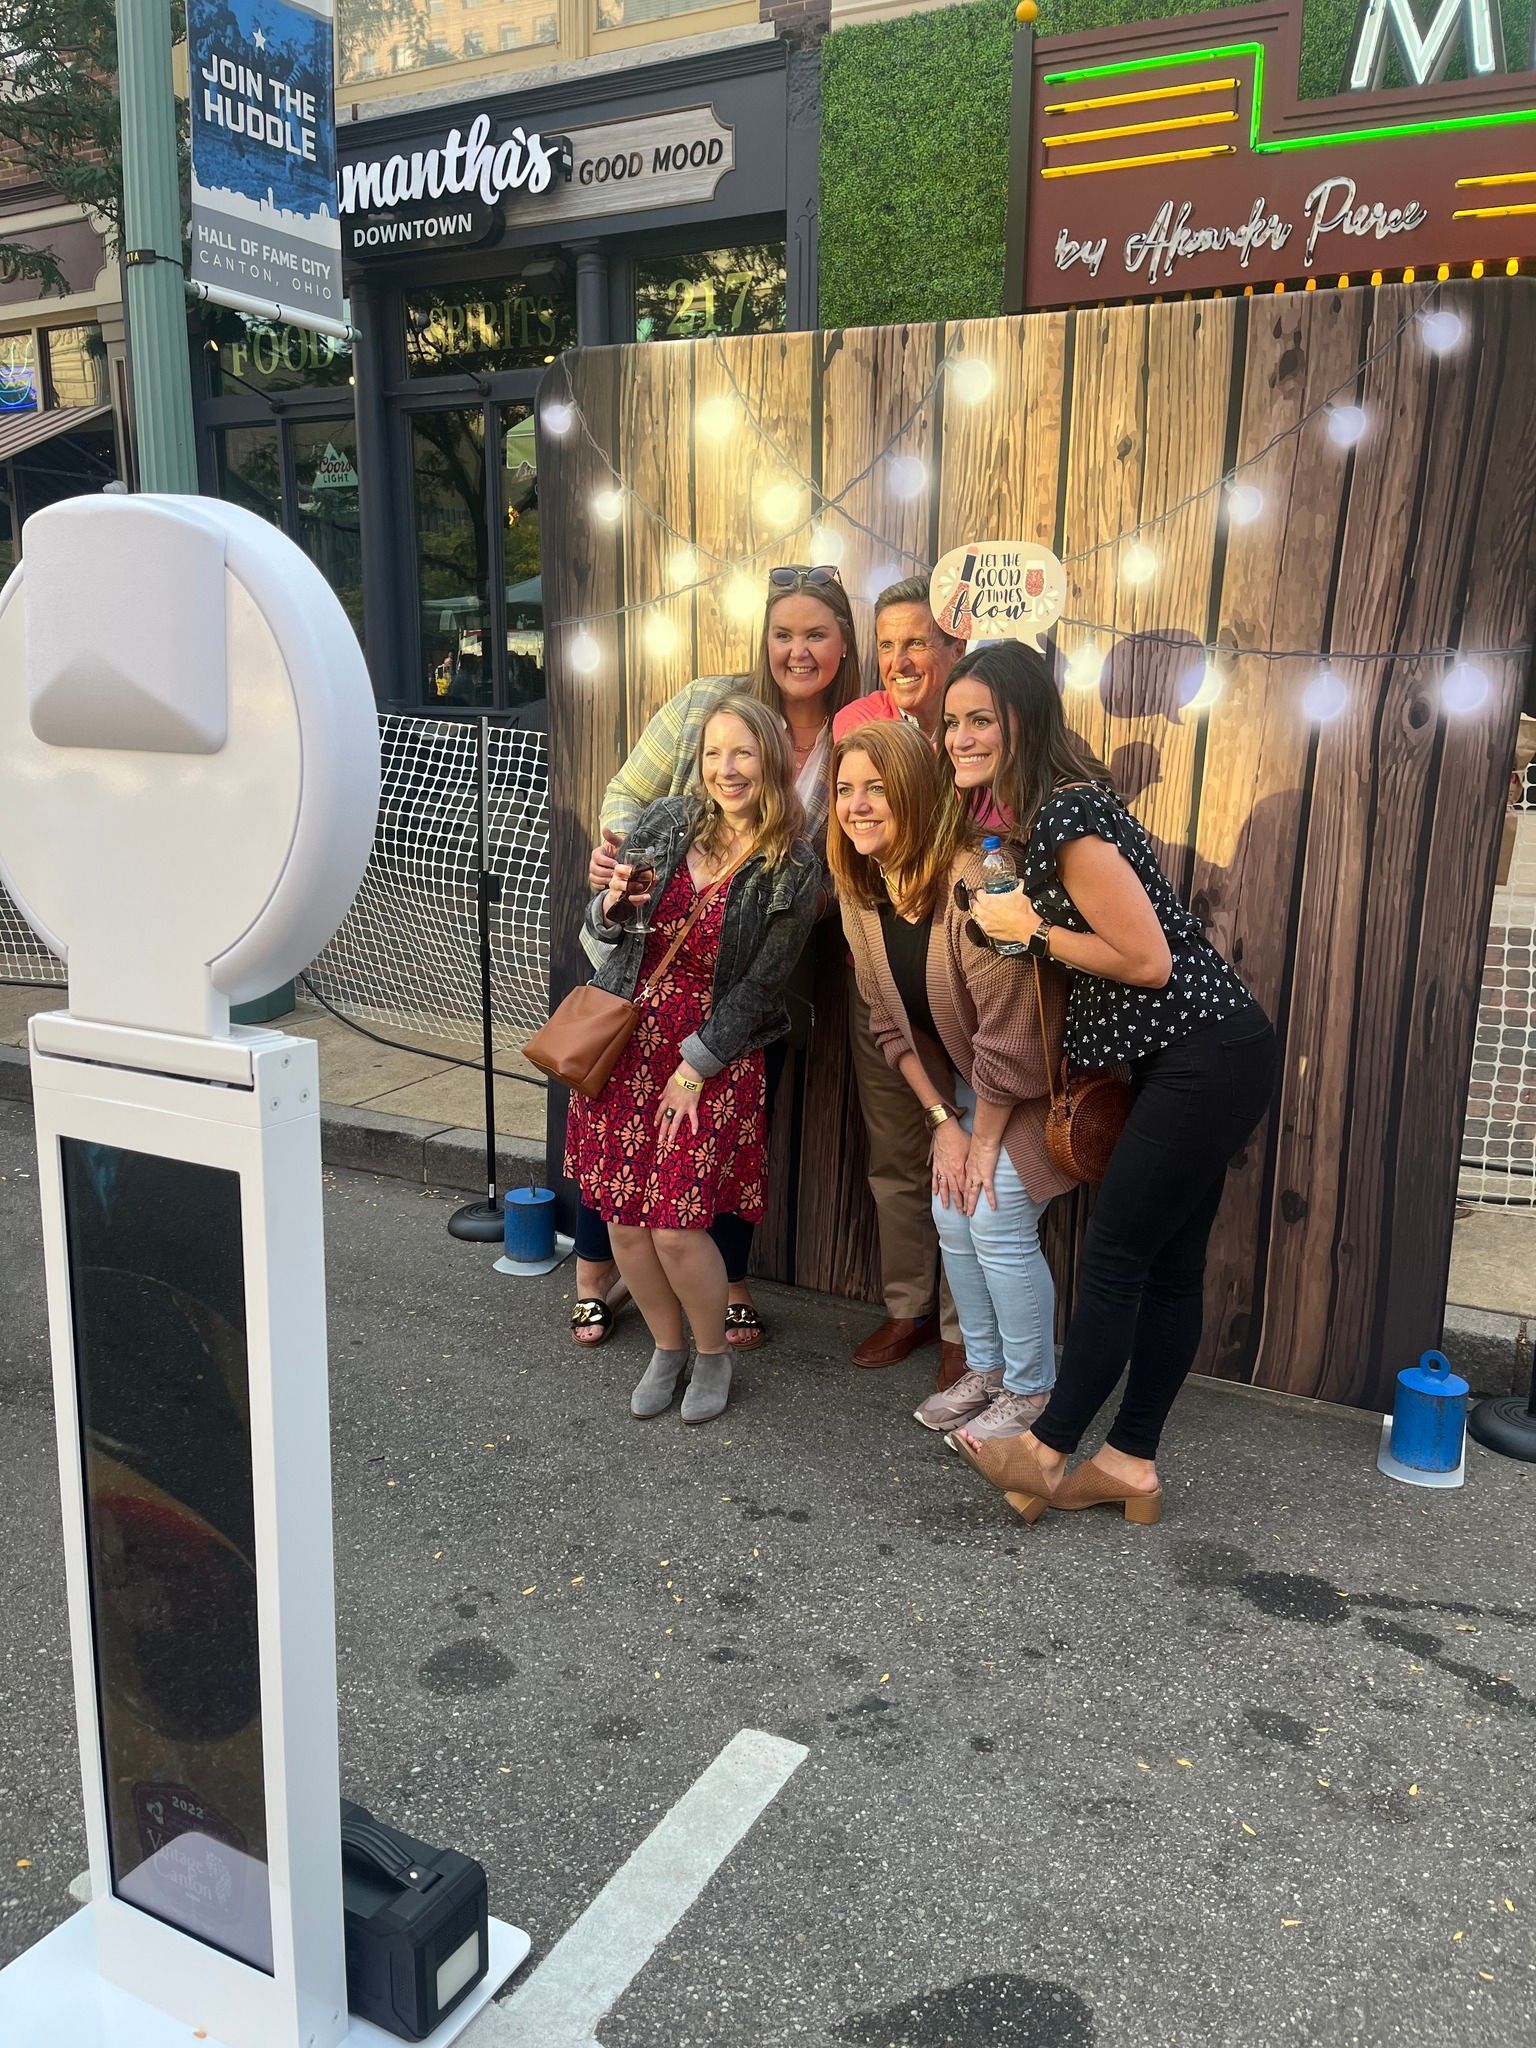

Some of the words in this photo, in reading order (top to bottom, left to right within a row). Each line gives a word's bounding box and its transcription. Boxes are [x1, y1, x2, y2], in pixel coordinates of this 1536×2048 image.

[201, 54, 263, 102] JOIN
[268, 77, 316, 124] THE
[203, 88, 317, 162] HUDDLE
[337, 113, 559, 215] mantha's
[579, 153, 644, 186] GOOD
[652, 137, 724, 174] MOOD
[353, 212, 473, 248] DOWNTOWN
[1055, 228, 1107, 277] by
[1303, 175, 1428, 268] Pierce
[197, 224, 237, 252] HALL
[240, 237, 258, 257] OF
[262, 246, 298, 271] FAME
[301, 256, 331, 281] CITY
[292, 276, 332, 301] OHIO
[666, 270, 753, 336] 217
[427, 295, 556, 354] SPIRITS
[231, 324, 337, 377] FOOD
[319, 457, 352, 474] Coors
[323, 474, 349, 484] LIGHT
[975, 568, 1021, 588] GOOD
[980, 553, 998, 567] LET
[1001, 553, 1022, 567] THE
[951, 589, 1033, 629] flow
[985, 588, 1022, 603] TIMES
[171, 1796, 205, 1820] 2022
